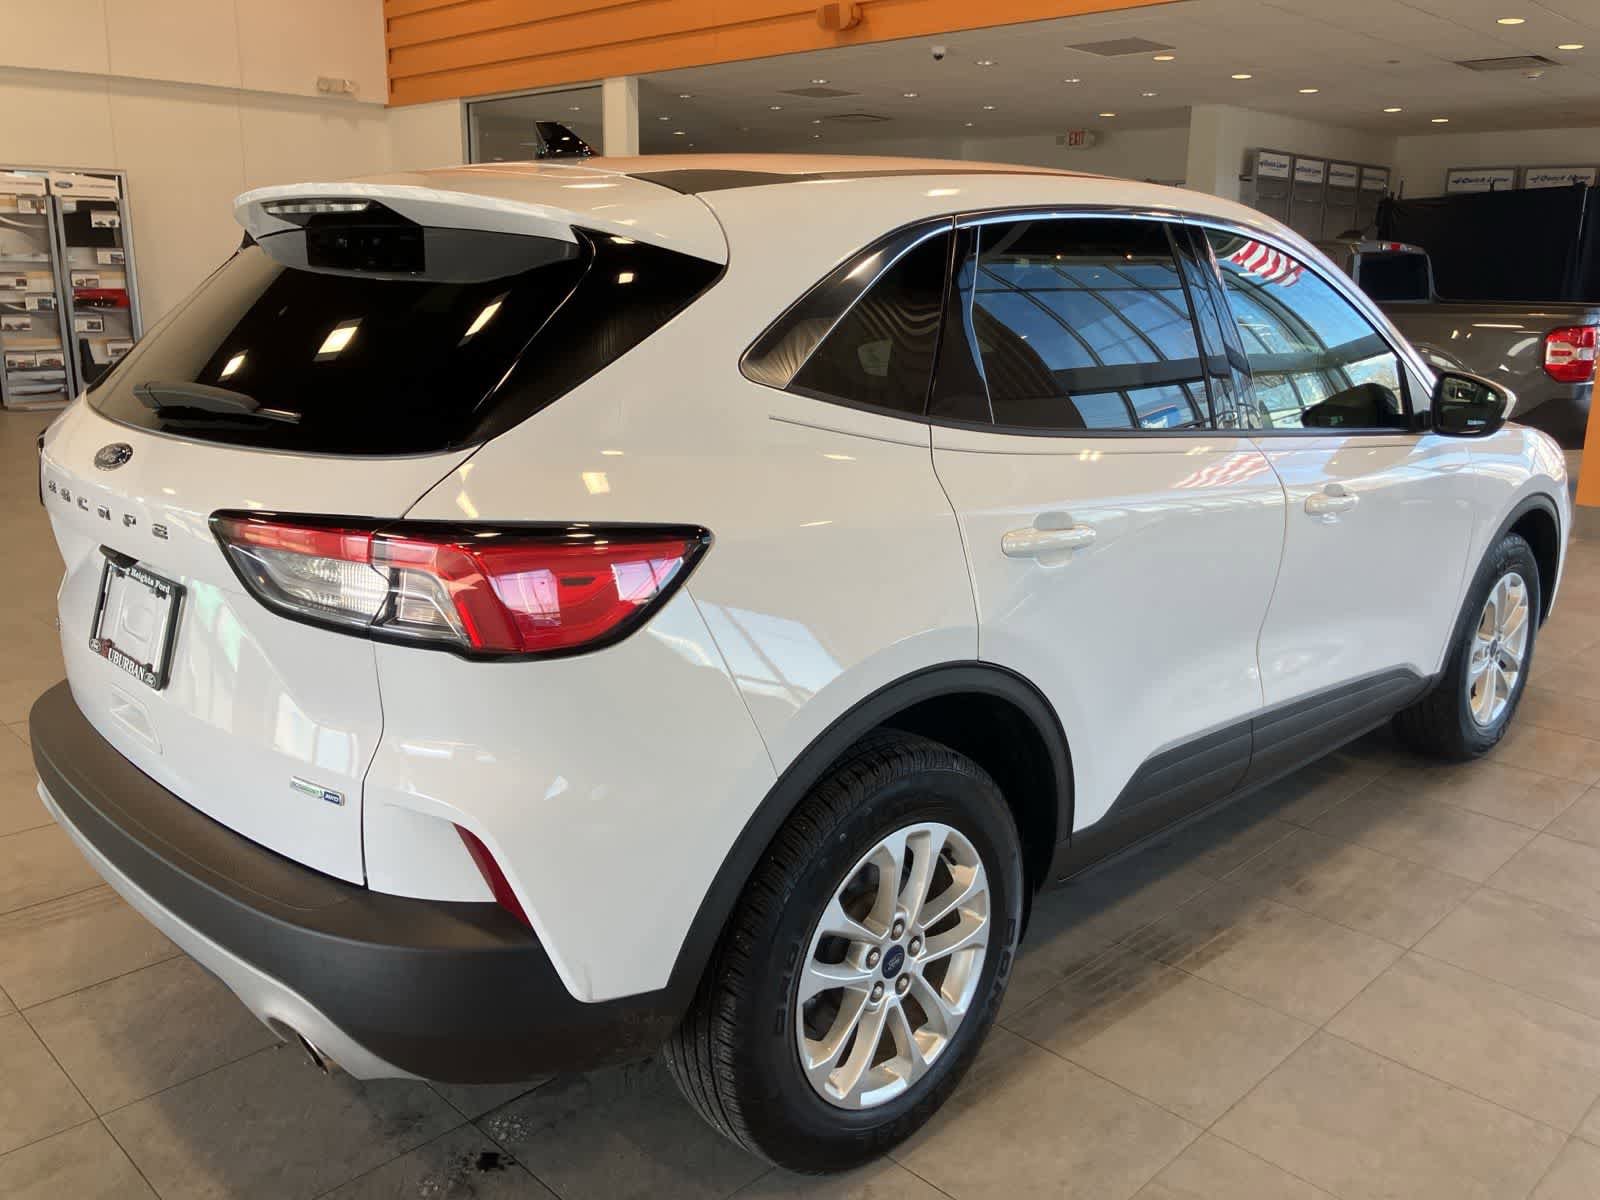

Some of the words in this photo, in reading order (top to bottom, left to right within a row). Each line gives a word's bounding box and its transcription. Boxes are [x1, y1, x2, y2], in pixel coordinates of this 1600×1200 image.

[48, 480, 169, 540] ESCAPE
[154, 579, 171, 594] Ford
[101, 641, 145, 681] SUBURBAN
